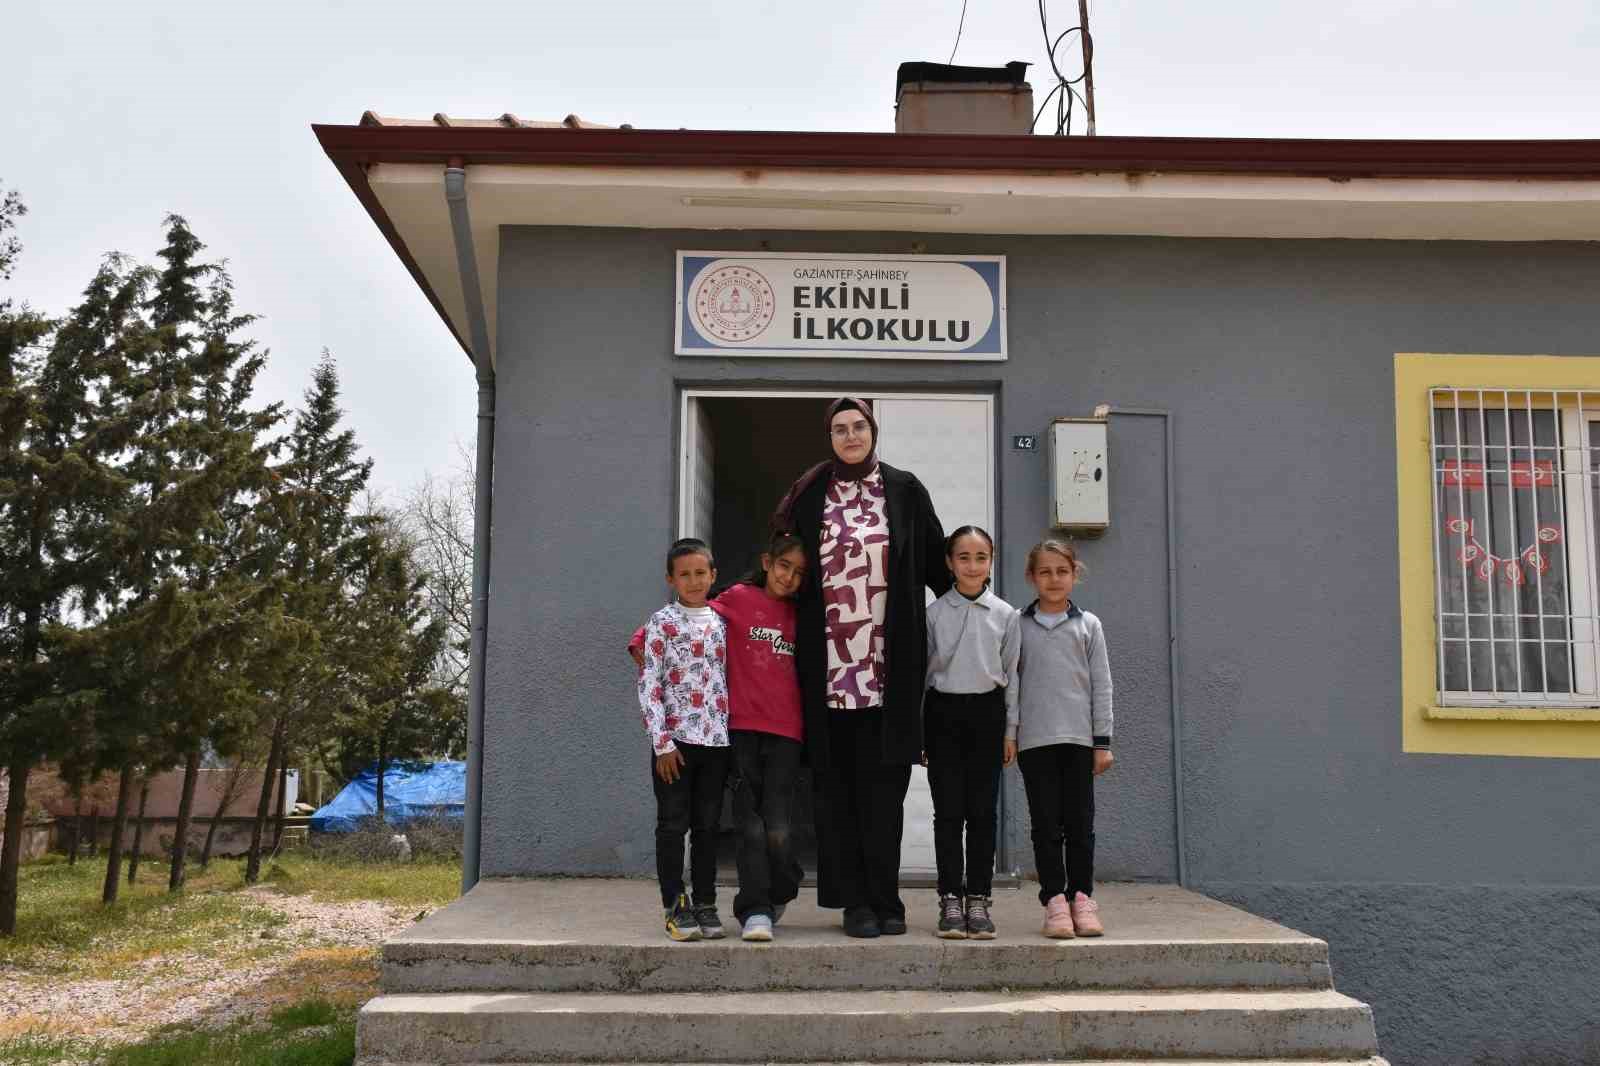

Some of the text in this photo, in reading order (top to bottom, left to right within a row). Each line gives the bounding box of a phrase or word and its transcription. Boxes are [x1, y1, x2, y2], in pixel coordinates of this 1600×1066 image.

[793, 282, 909, 310] EKİNLİ
[793, 312, 970, 342] İLKOKULU
[1018, 437, 1031, 448] 42
[751, 626, 773, 640] Star
